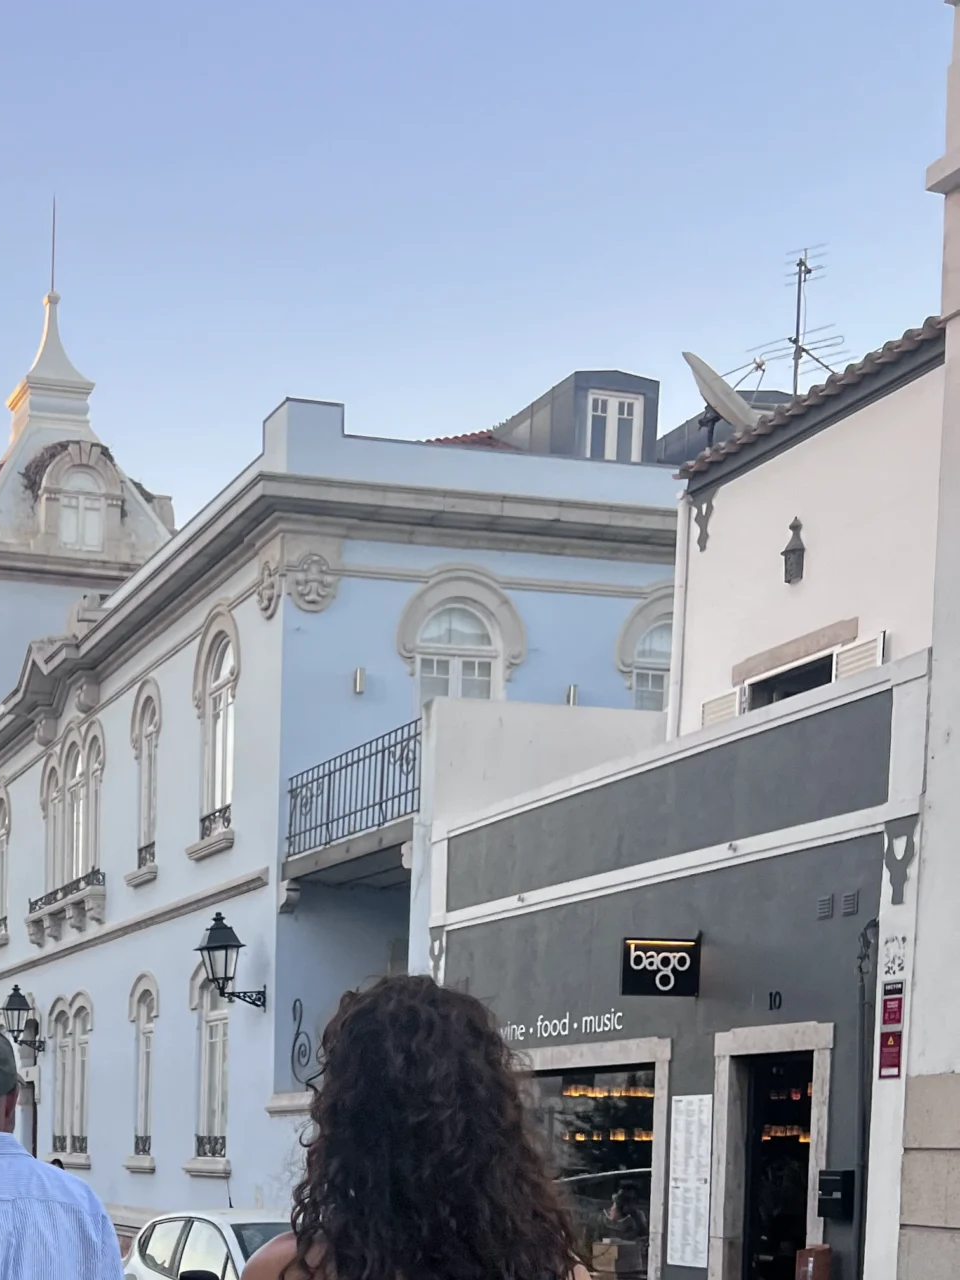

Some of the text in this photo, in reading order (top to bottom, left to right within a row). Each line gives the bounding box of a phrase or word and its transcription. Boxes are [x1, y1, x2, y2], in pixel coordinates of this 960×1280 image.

[630, 943, 691, 991] bago
[768, 991, 782, 1011] 10
[536, 1011, 570, 1038] food
[582, 1008, 623, 1034] music
